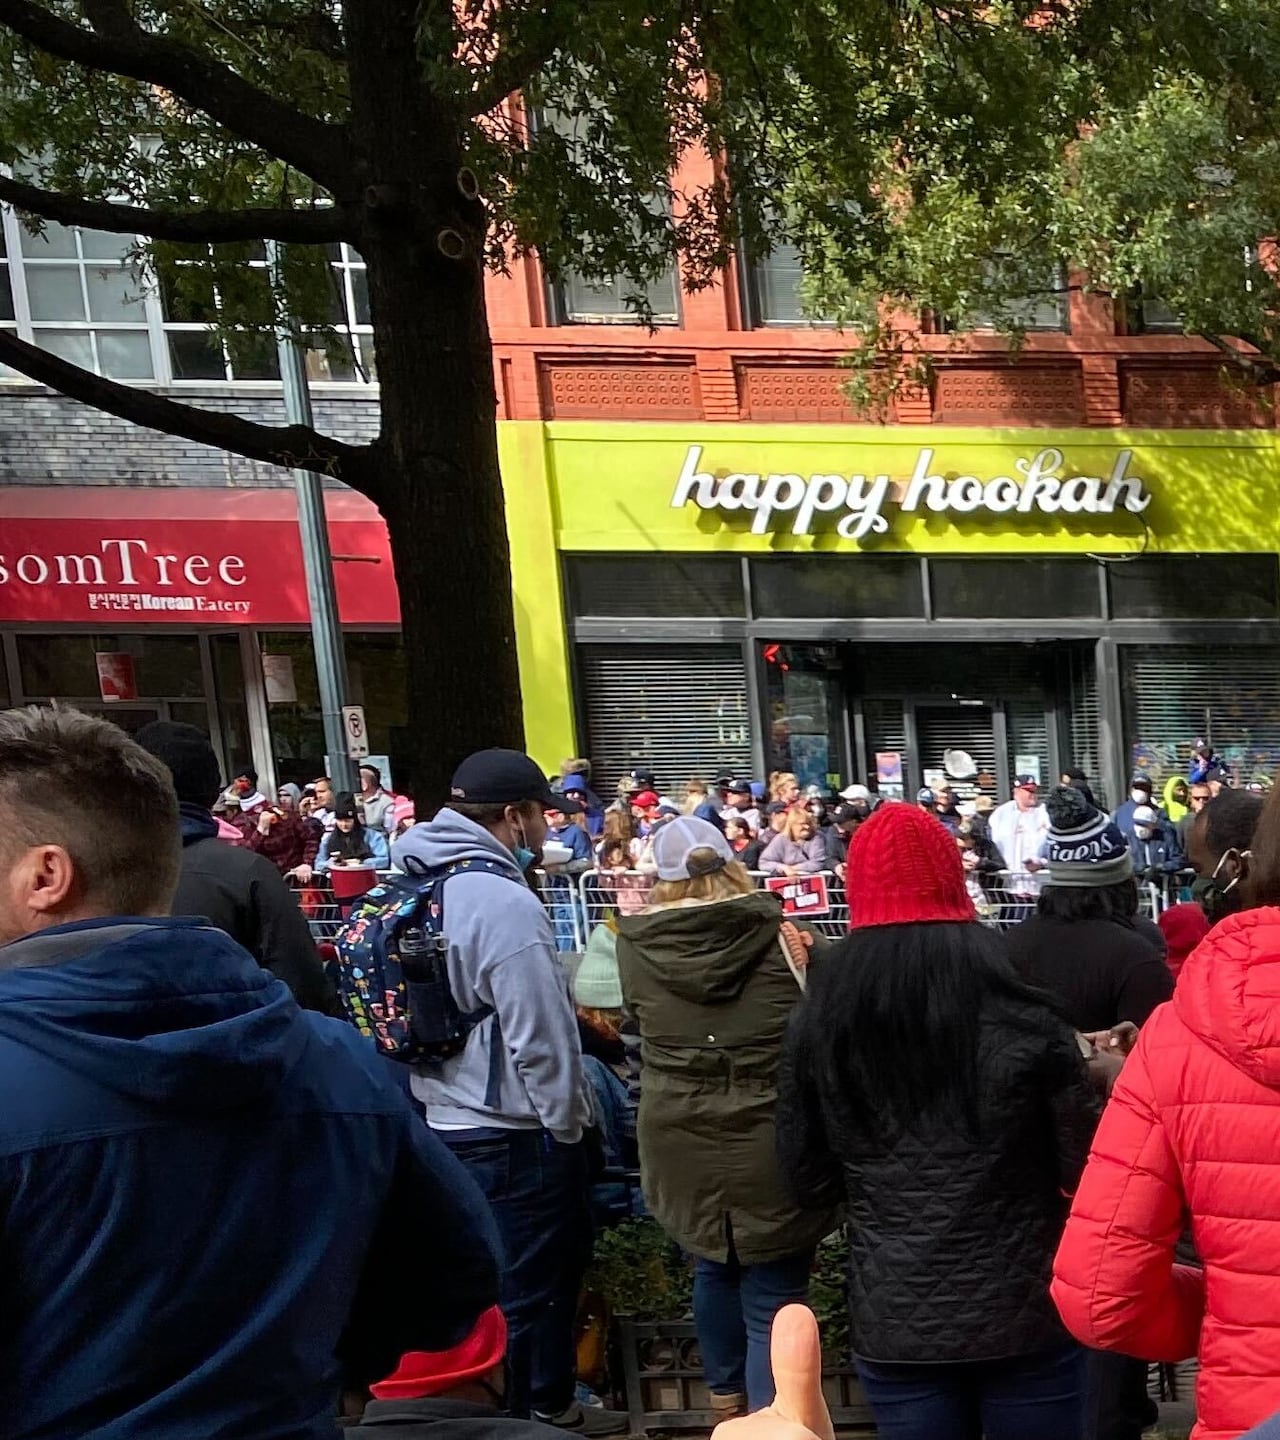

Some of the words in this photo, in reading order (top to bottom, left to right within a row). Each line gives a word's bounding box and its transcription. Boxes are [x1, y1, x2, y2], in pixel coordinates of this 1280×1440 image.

[670, 444, 889, 538] happy
[900, 448, 1151, 513] hookah
[196, 596, 251, 614] Eatery
